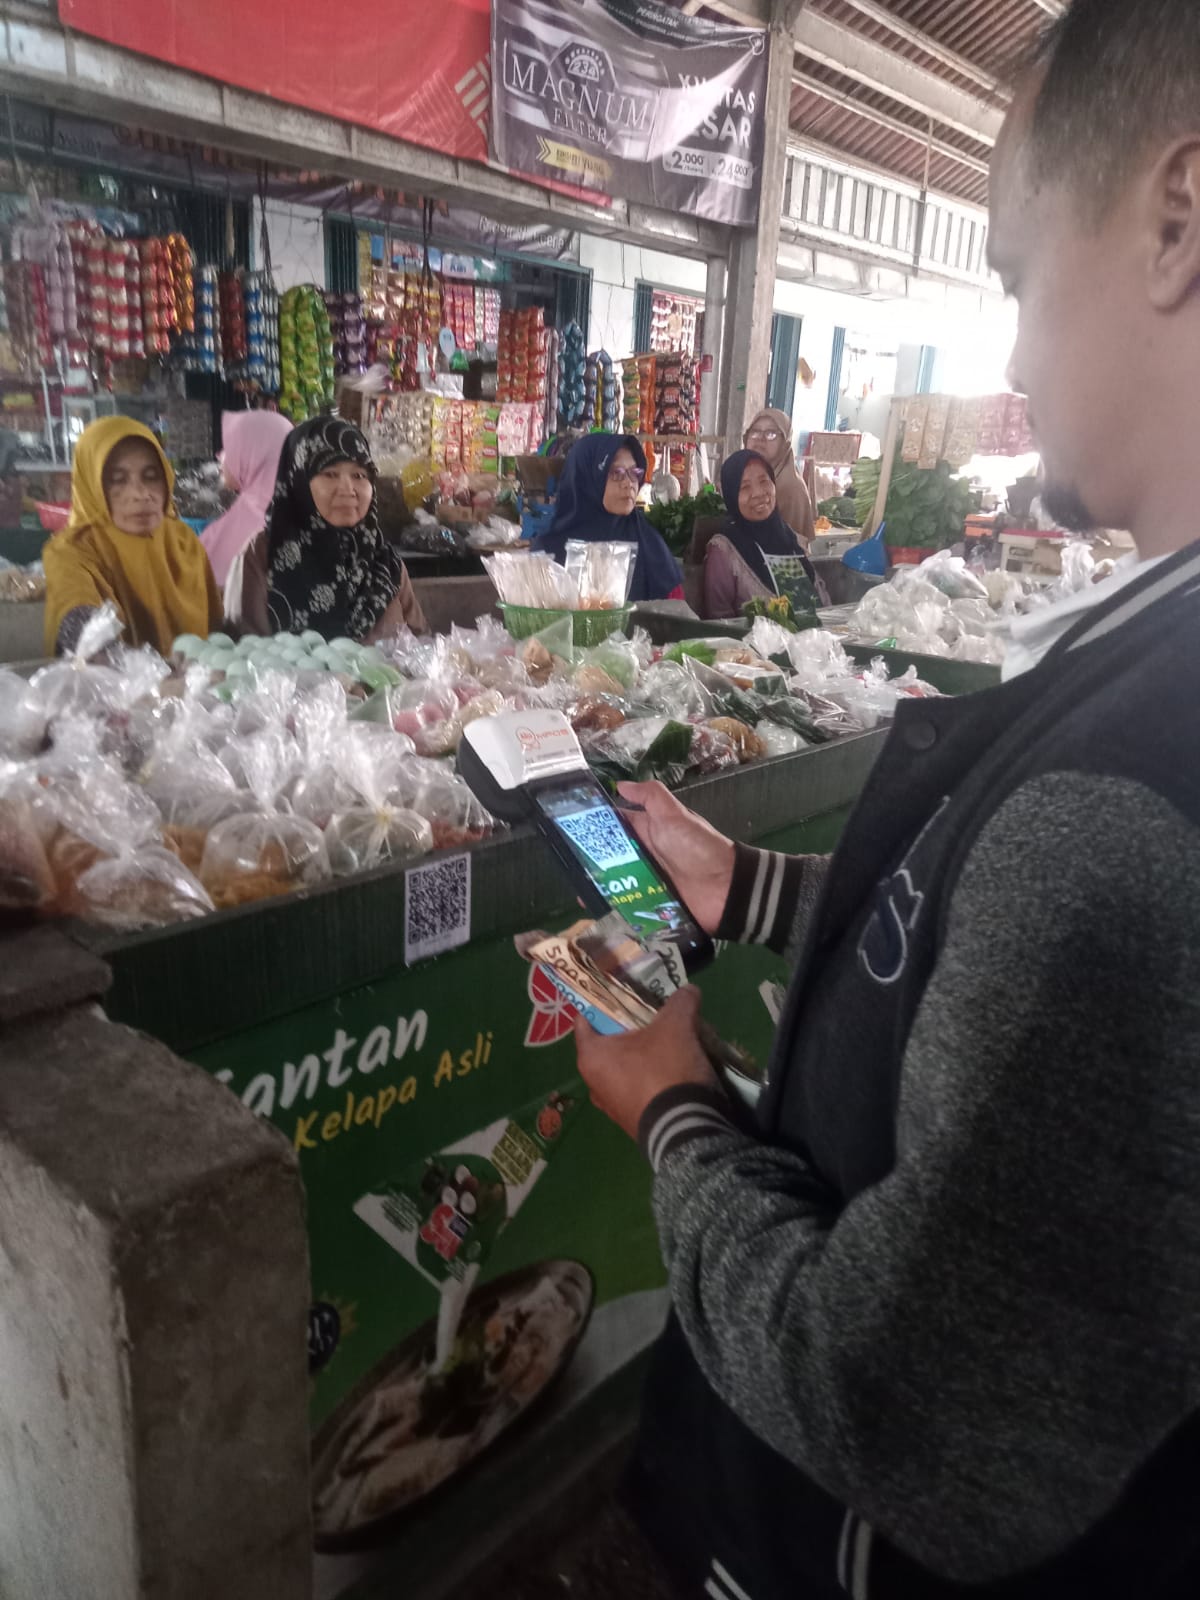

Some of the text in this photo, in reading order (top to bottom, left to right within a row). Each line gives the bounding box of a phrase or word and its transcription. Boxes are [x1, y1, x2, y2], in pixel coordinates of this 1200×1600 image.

[511, 53, 650, 131] MAGNUM
[573, 60, 597, 78] 234
[553, 108, 607, 144] FILTER
[294, 1030, 494, 1151] Kelapa Asli
